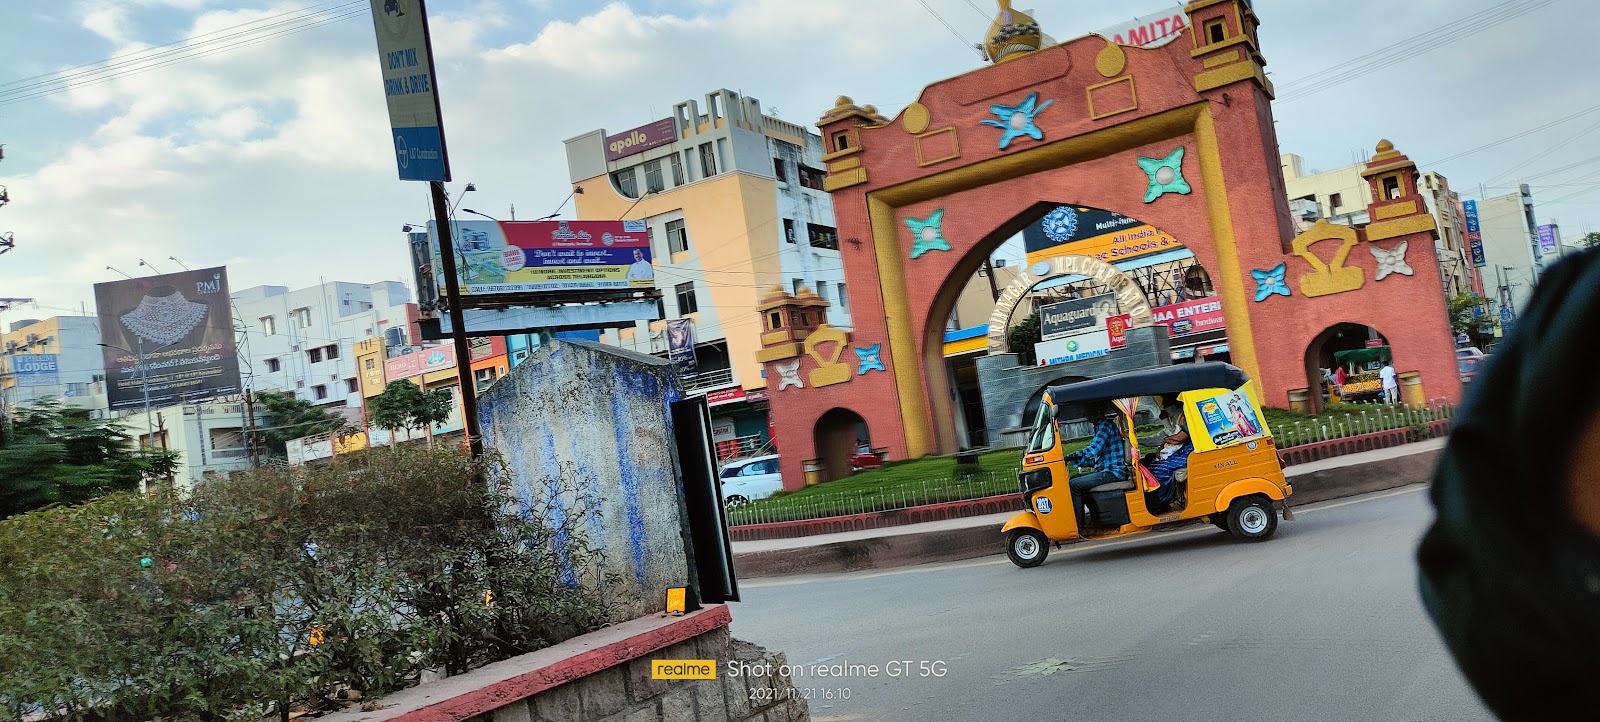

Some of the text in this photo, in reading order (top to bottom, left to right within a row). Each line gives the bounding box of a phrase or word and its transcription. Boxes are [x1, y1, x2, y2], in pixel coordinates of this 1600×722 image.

[387, 47, 418, 70] DON'T MIX
[385, 77, 404, 96] DRINK
[409, 74, 429, 93] DRIVE
[609, 130, 647, 154] apollo
[1111, 240, 1158, 257] Schools
[1161, 237, 1170, 246] &
[1112, 230, 1154, 244] All India
[1055, 256, 1078, 274] MPL
[196, 278, 220, 293] PMJ
[1043, 302, 1096, 326] Aquaguard
[17, 361, 57, 372] LODGE
